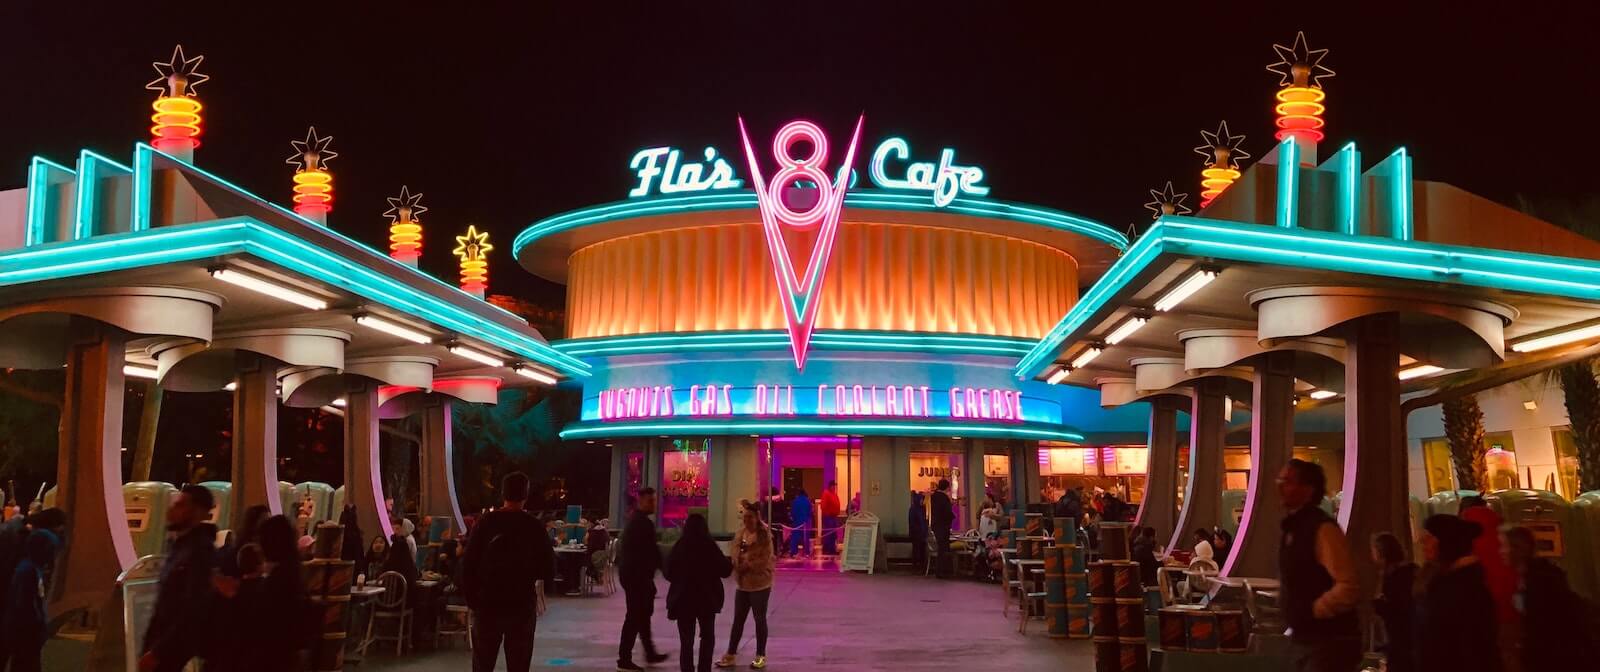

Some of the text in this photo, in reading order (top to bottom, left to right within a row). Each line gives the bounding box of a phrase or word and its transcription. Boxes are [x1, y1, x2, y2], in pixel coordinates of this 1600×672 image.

[871, 137, 990, 208] Cafe
[598, 384, 1025, 420] LUGNUTS GAS OIL COOLANT GREASE
